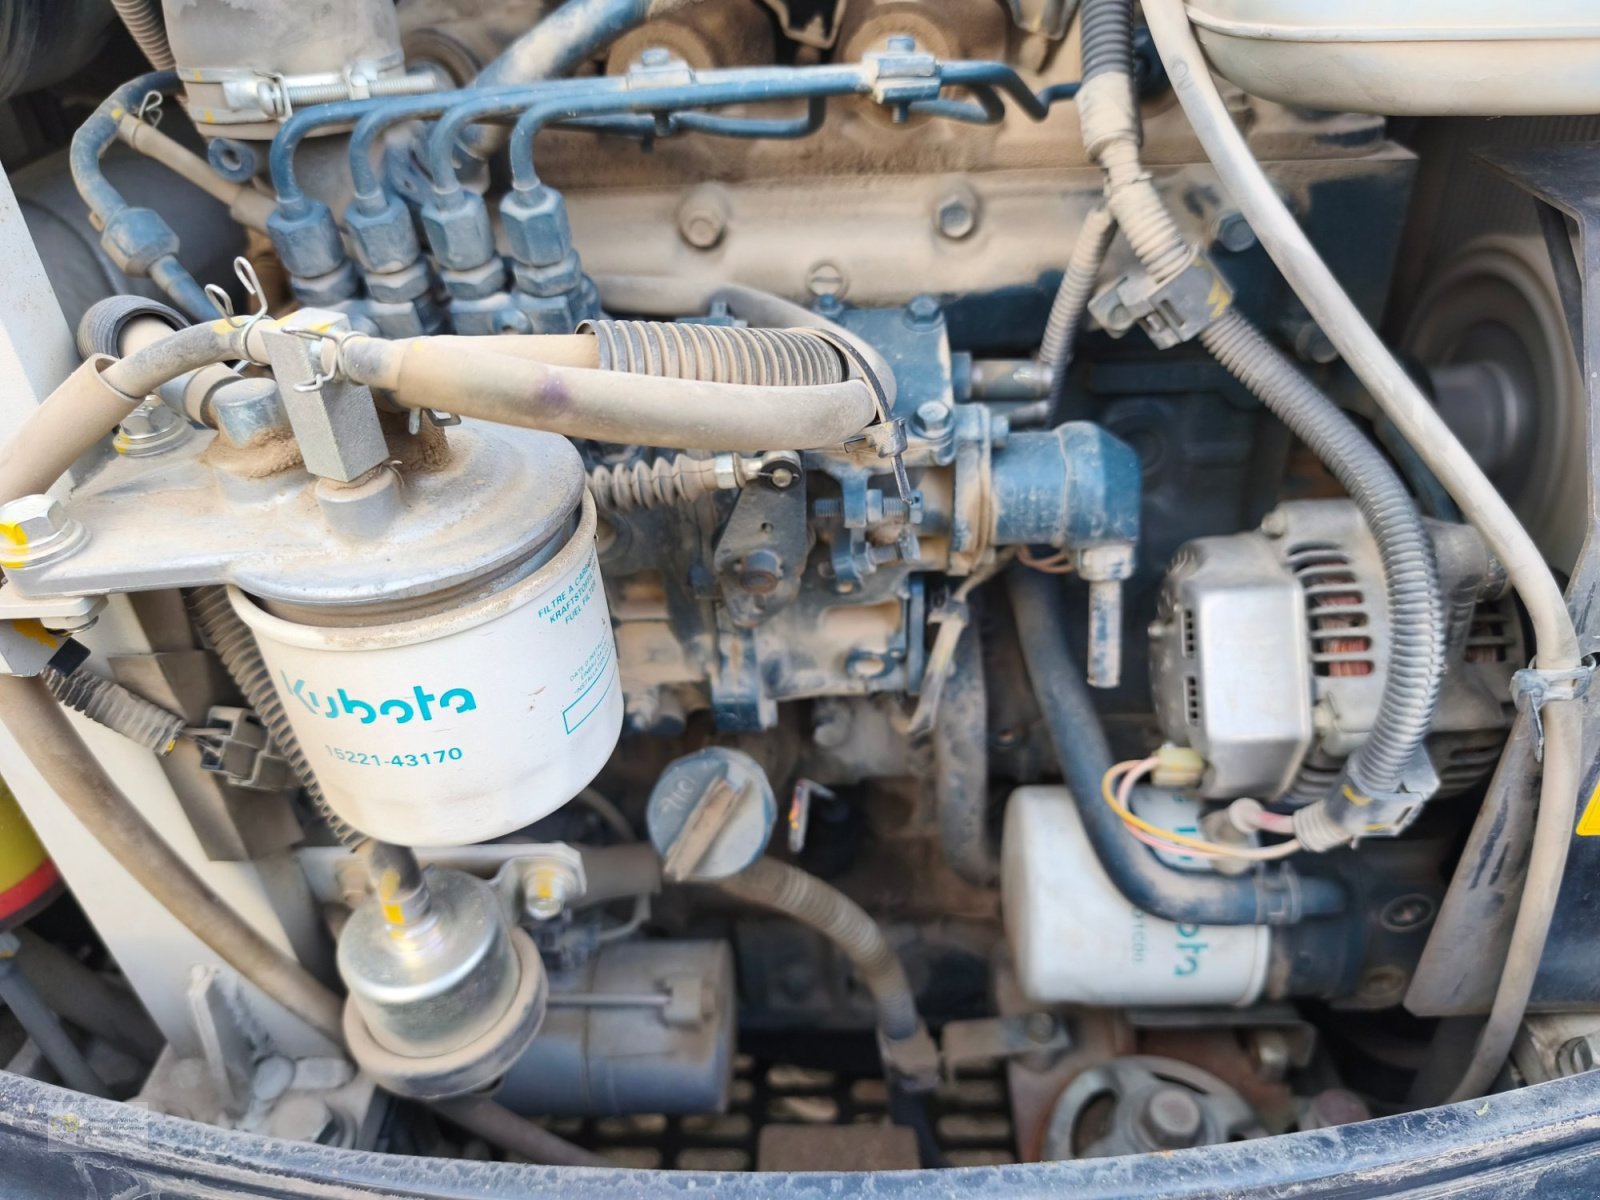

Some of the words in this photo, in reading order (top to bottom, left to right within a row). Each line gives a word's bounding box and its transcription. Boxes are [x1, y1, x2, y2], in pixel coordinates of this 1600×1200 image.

[538, 591, 567, 618] FILTRE
[565, 605, 582, 624] FUEL
[280, 669, 477, 724] Kubota
[324, 744, 463, 768] 15221-43170
